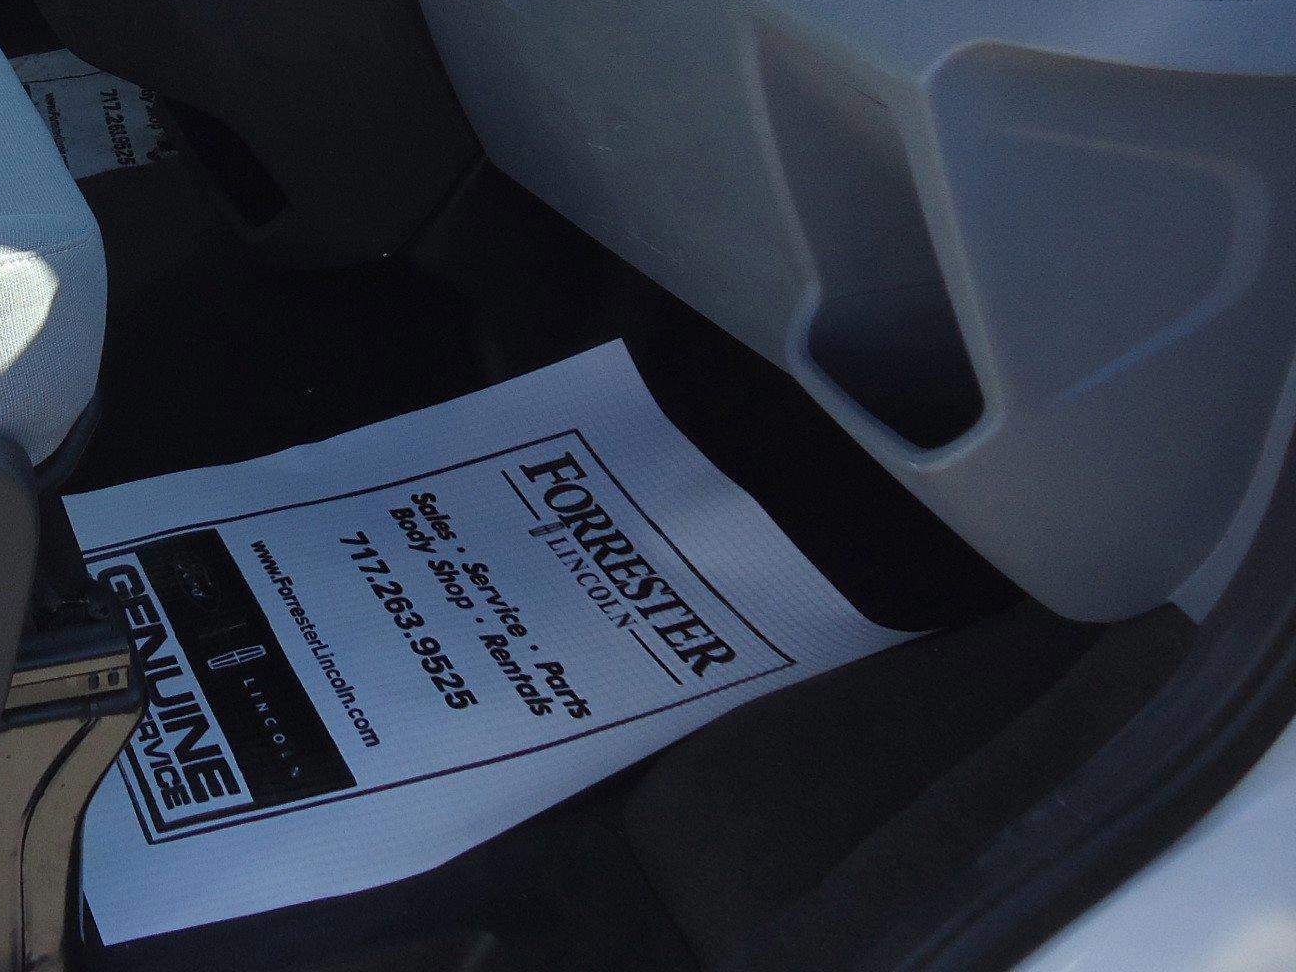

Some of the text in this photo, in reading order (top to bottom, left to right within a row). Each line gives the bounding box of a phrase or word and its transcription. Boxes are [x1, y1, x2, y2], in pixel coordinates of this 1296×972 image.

[250, 540, 381, 749] www.ForresterLincoln.com
[339, 530, 480, 710] 717.263.9525
[388, 506, 554, 717] Body Shop Rentals
[410, 492, 592, 719] Sales Service Parts
[519, 451, 737, 678] FORRESTER
[546, 536, 638, 628] LINCOLN
[97, 563, 242, 805] GENUINE
[138, 710, 192, 811] RVICE
